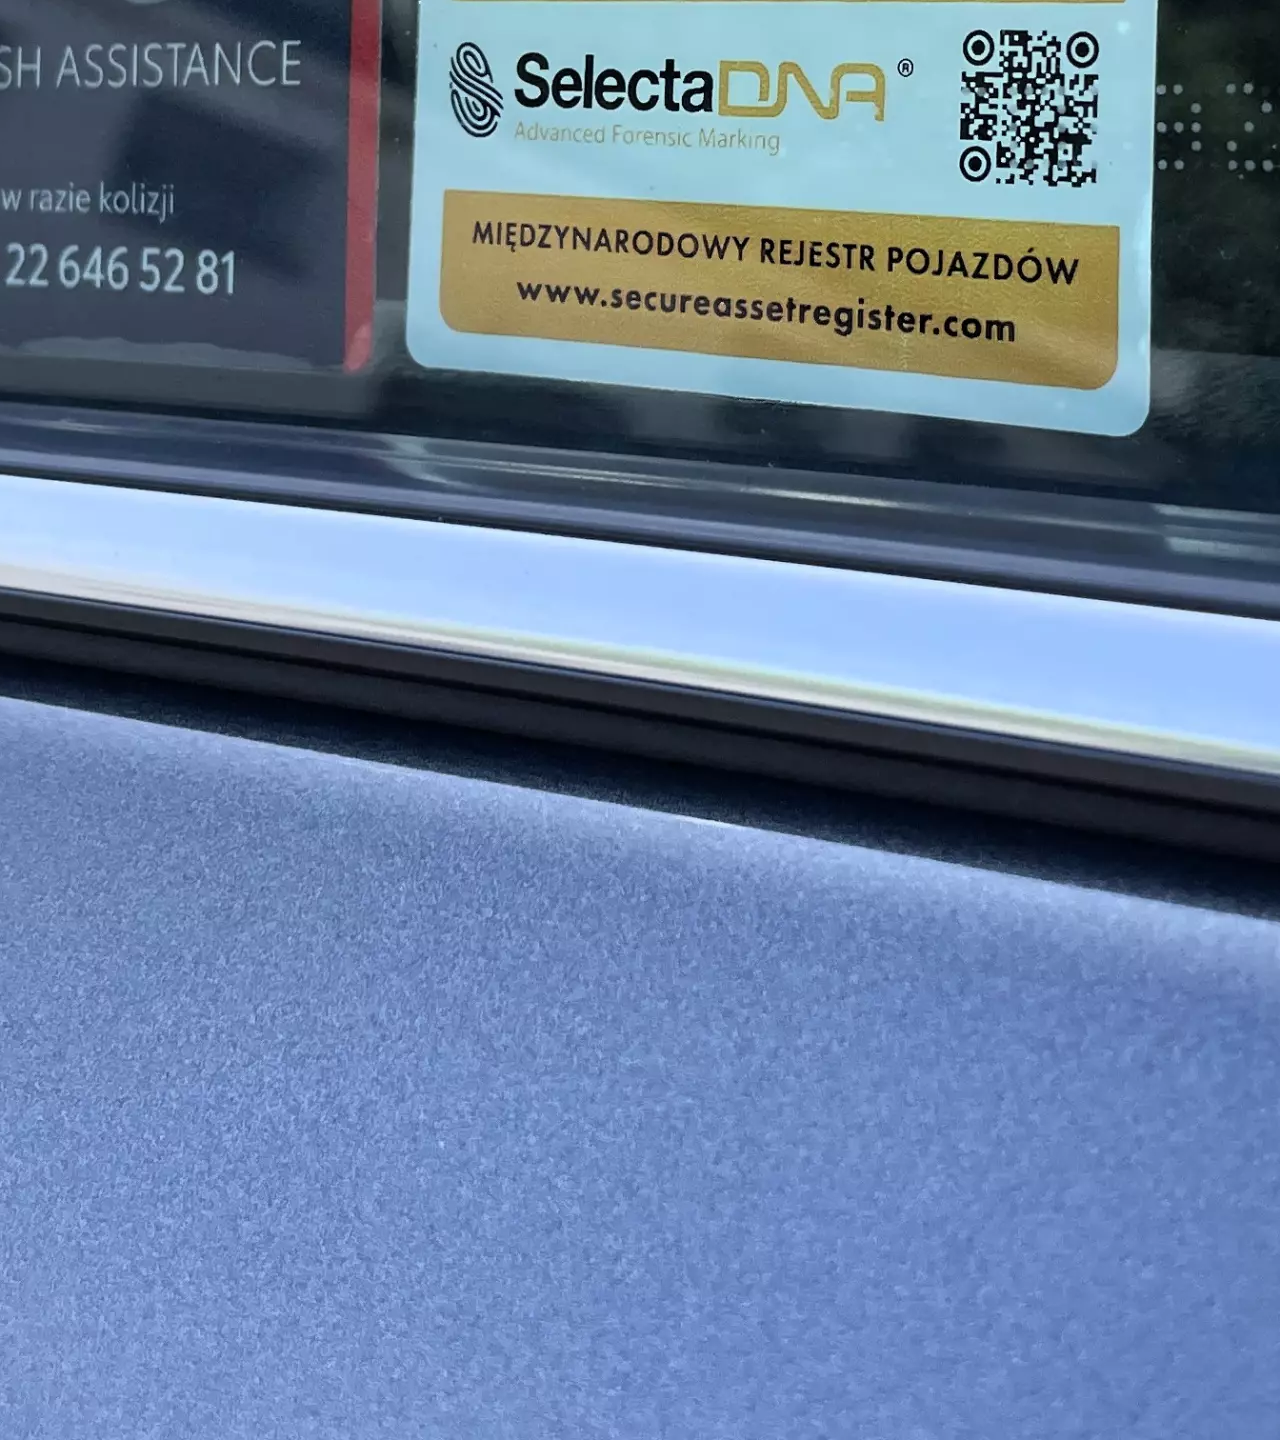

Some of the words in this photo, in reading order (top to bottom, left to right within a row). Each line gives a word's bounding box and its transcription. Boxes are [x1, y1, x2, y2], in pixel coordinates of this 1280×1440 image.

[56, 39, 302, 89] ASSISTANCE
[514, 120, 606, 147] Advanced
[611, 125, 693, 150] Forensic
[698, 128, 780, 155] Marking
[0, 189, 22, 211] w
[29, 182, 91, 214] razie
[99, 181, 175, 224] kolizji
[5, 242, 49, 287] 22
[58, 244, 129, 290] 646
[139, 247, 185, 293] 52
[195, 249, 235, 295] 81
[472, 219, 750, 265] MIĘDZYNARODOWY
[760, 237, 875, 273] REJESTR
[887, 246, 1080, 285] POJAZDÓW
[516, 280, 1016, 344] www.secureassetregister.com
